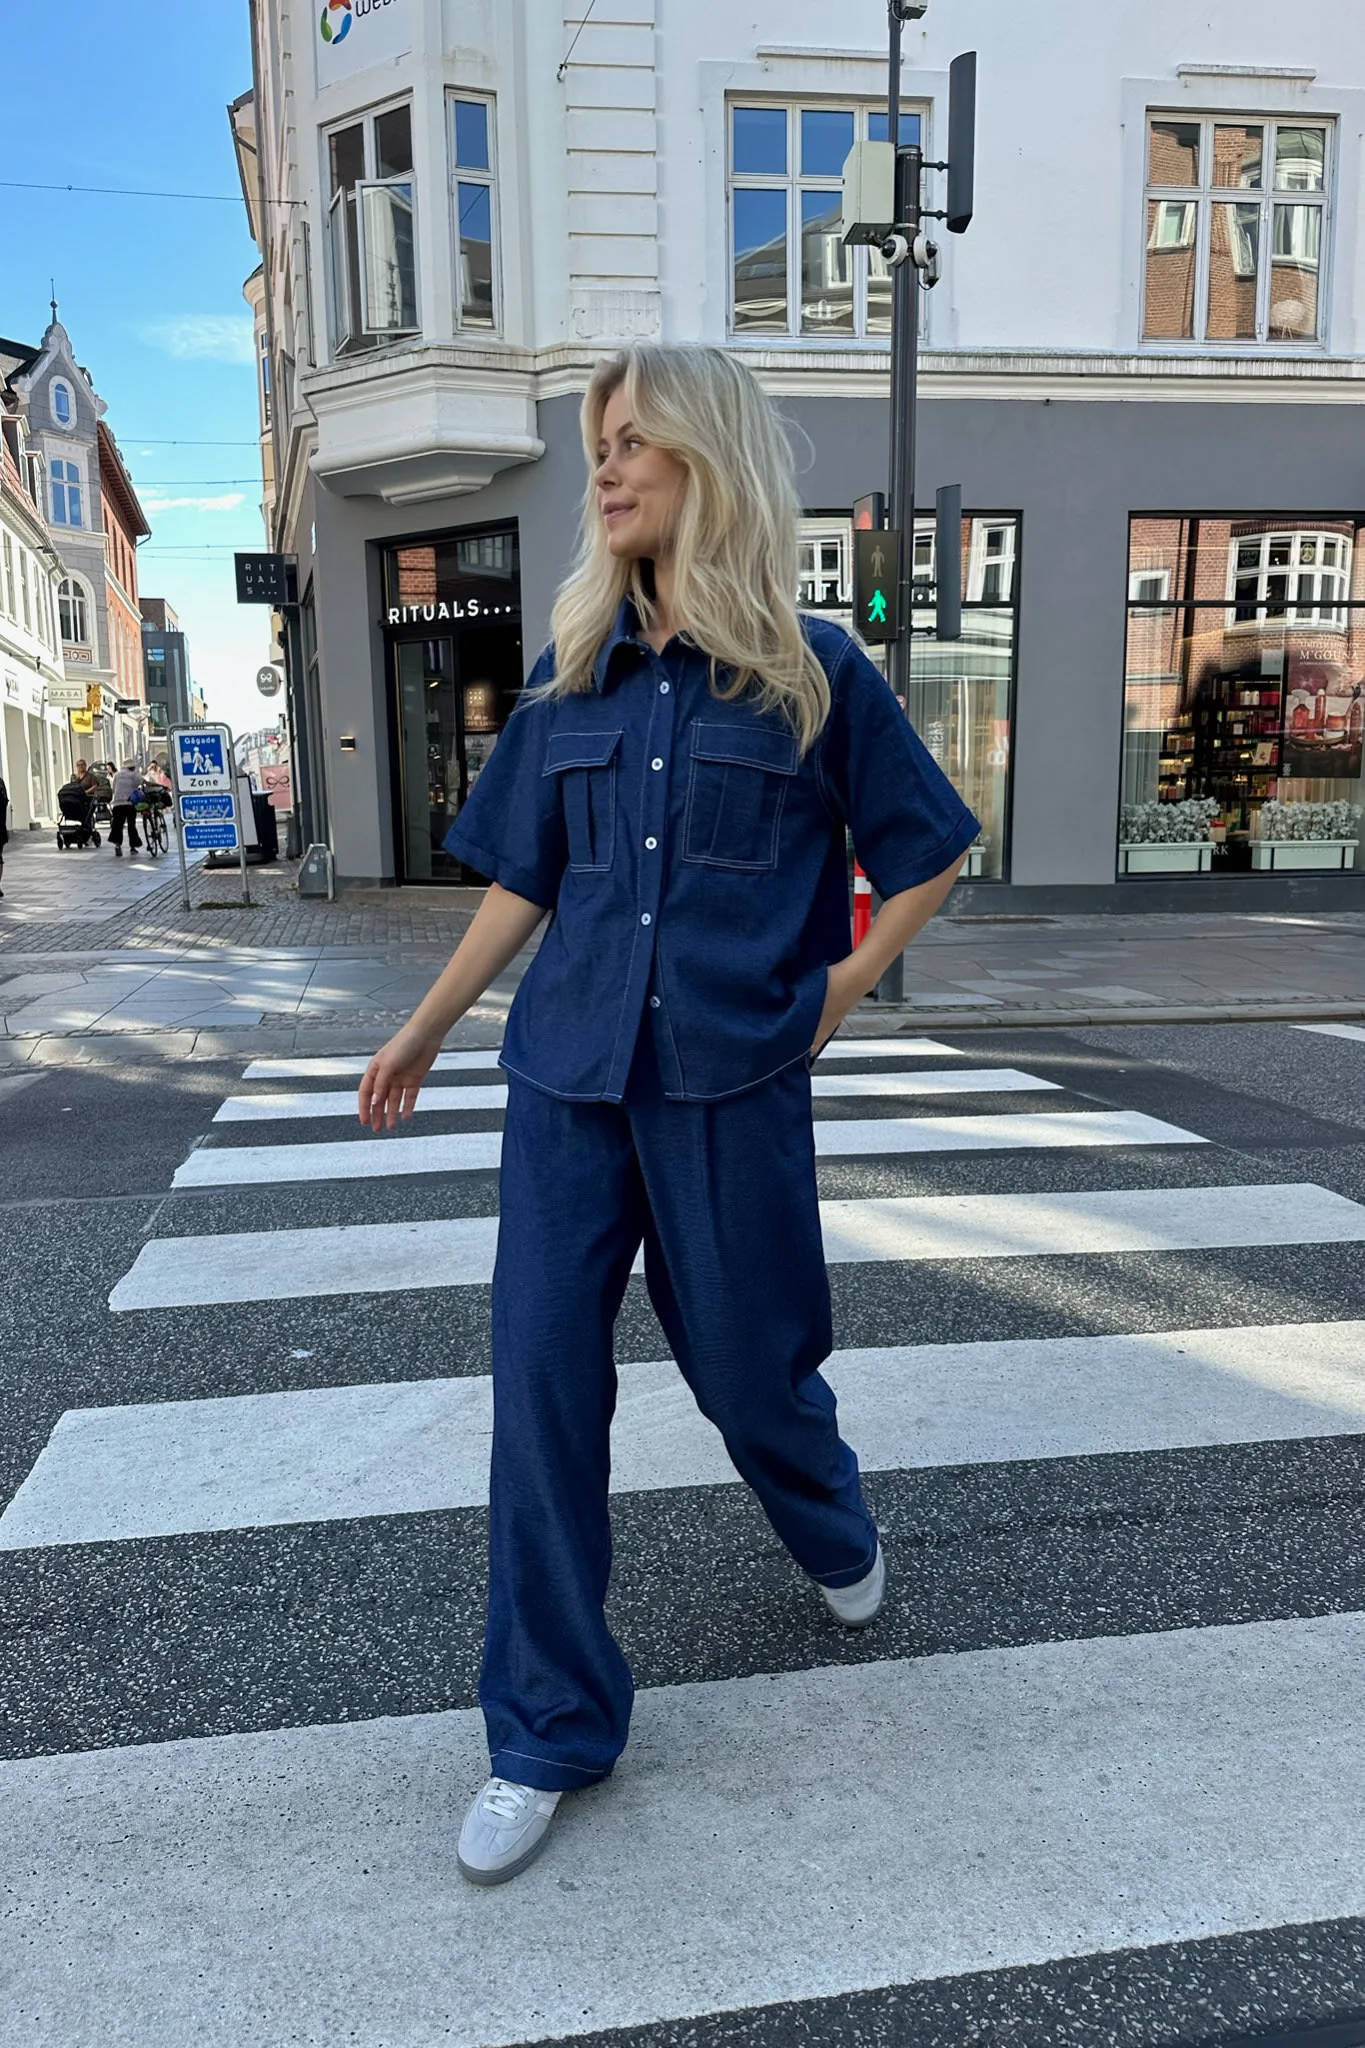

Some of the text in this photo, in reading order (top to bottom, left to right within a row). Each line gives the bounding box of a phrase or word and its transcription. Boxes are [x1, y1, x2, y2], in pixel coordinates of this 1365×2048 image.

[389, 599, 510, 624] RITUALS...
[50, 690, 83, 698] MASAI
[190, 778, 218, 787] Zone
